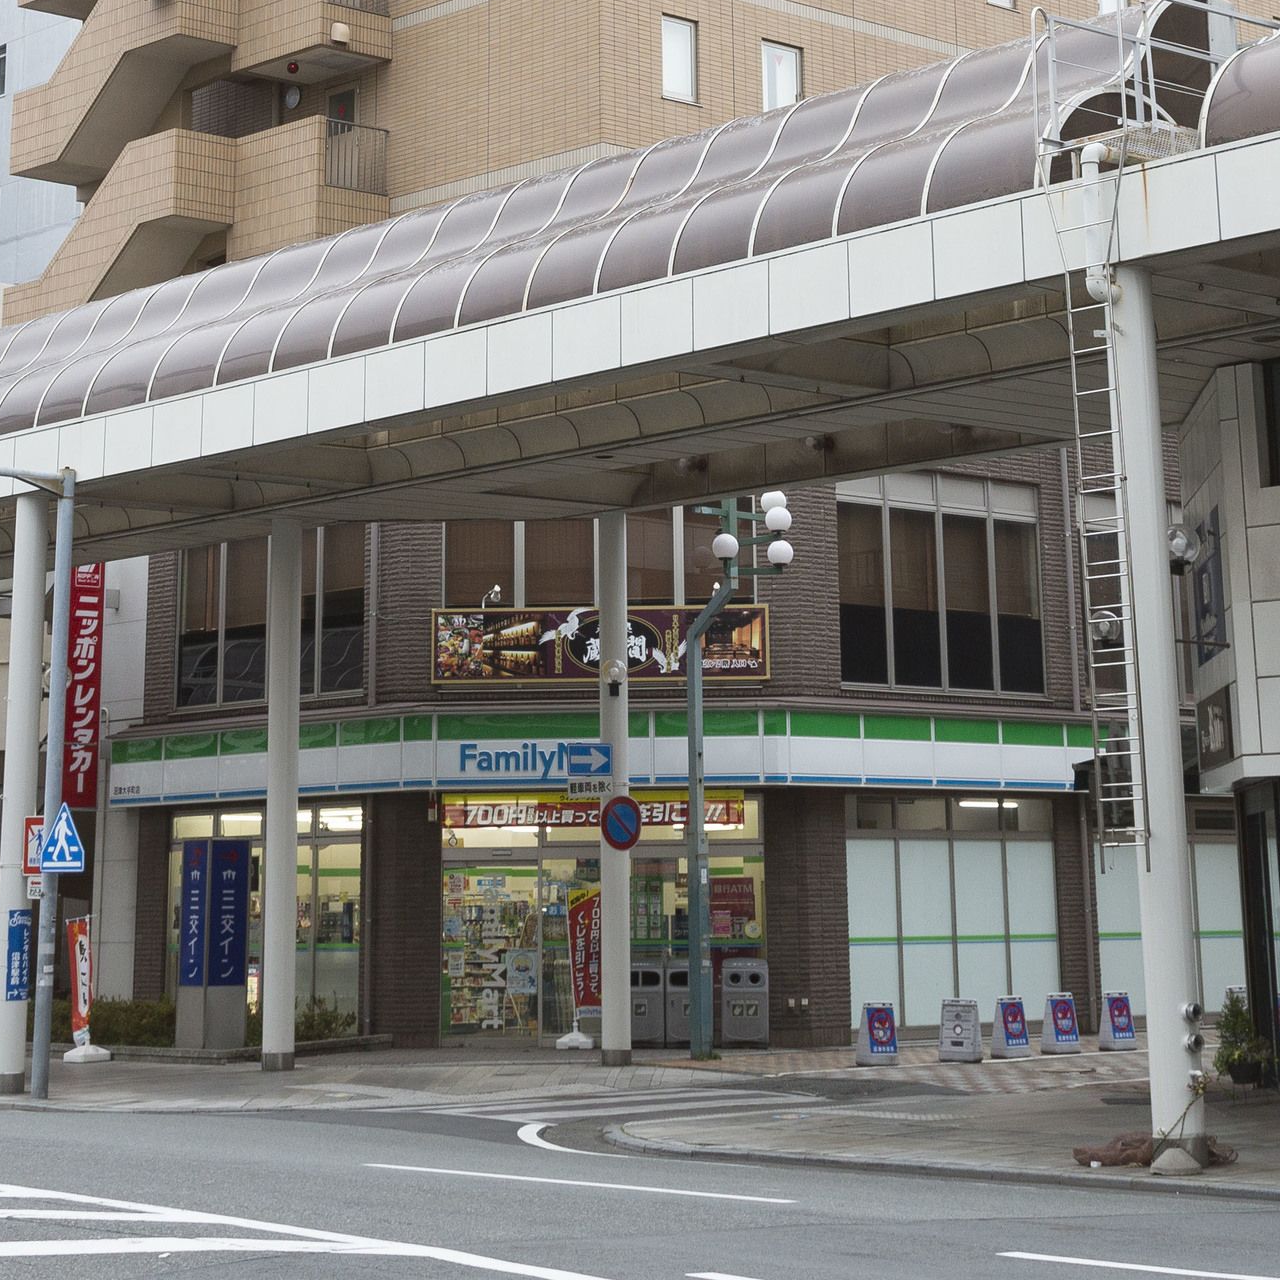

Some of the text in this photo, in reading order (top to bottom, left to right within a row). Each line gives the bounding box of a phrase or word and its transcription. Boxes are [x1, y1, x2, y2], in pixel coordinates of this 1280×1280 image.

[70, 595, 99, 793] ニッポンレンタカー
[583, 634, 649, 663] 蔵間
[188, 888, 200, 979] 三交イン
[219, 888, 236, 979] 三交イン
